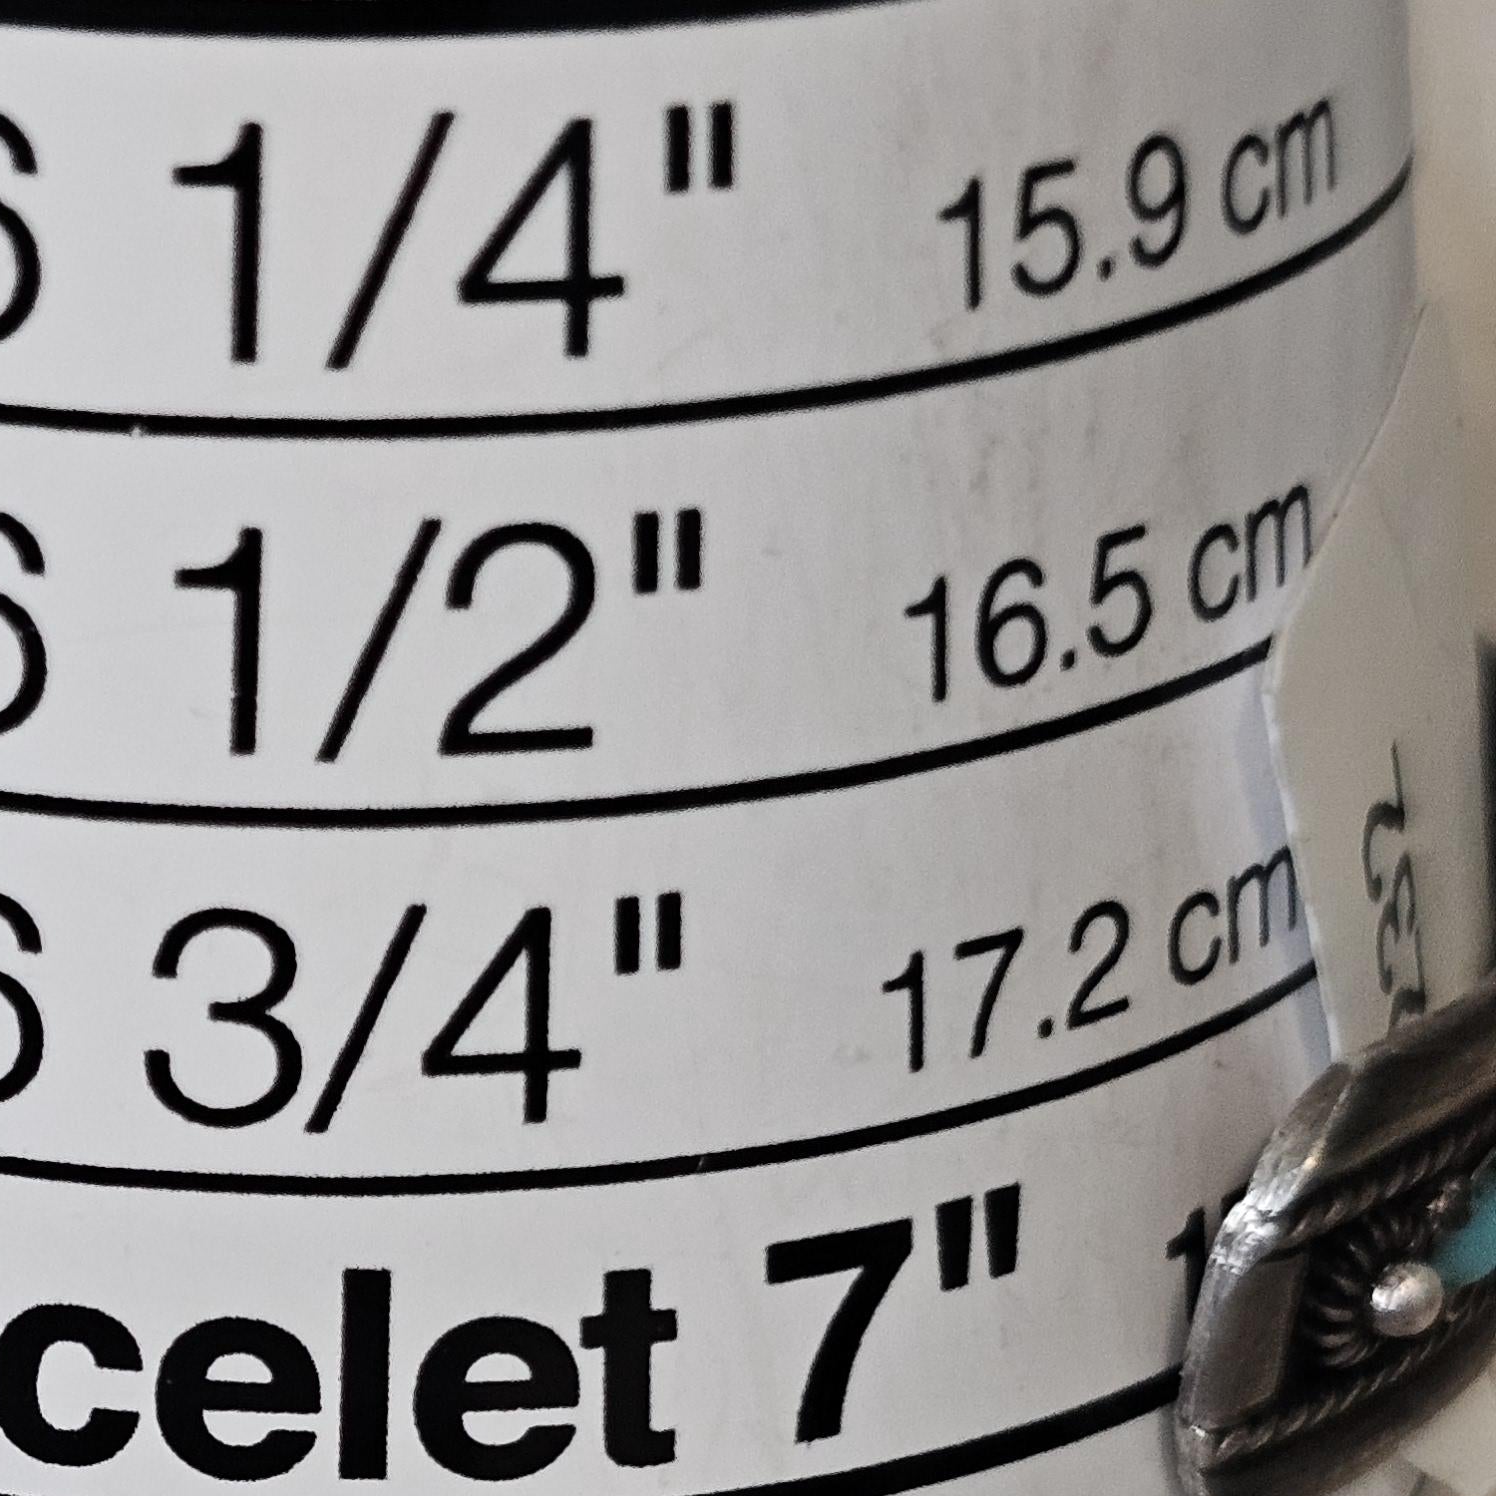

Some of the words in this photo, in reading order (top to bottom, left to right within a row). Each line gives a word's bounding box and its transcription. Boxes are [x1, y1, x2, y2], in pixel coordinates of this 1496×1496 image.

[170, 97, 738, 374] 1/4"
[936, 129, 1192, 313] 15.9
[1220, 94, 1341, 238] cm
[172, 505, 705, 766] 1/2"
[902, 520, 1157, 705] 16.5
[1186, 480, 1315, 625] cm
[142, 888, 685, 1137] 3/4"
[880, 896, 1134, 1075] 17.2
[1166, 843, 1300, 988] cm
[763, 1179, 1023, 1447] 7"
